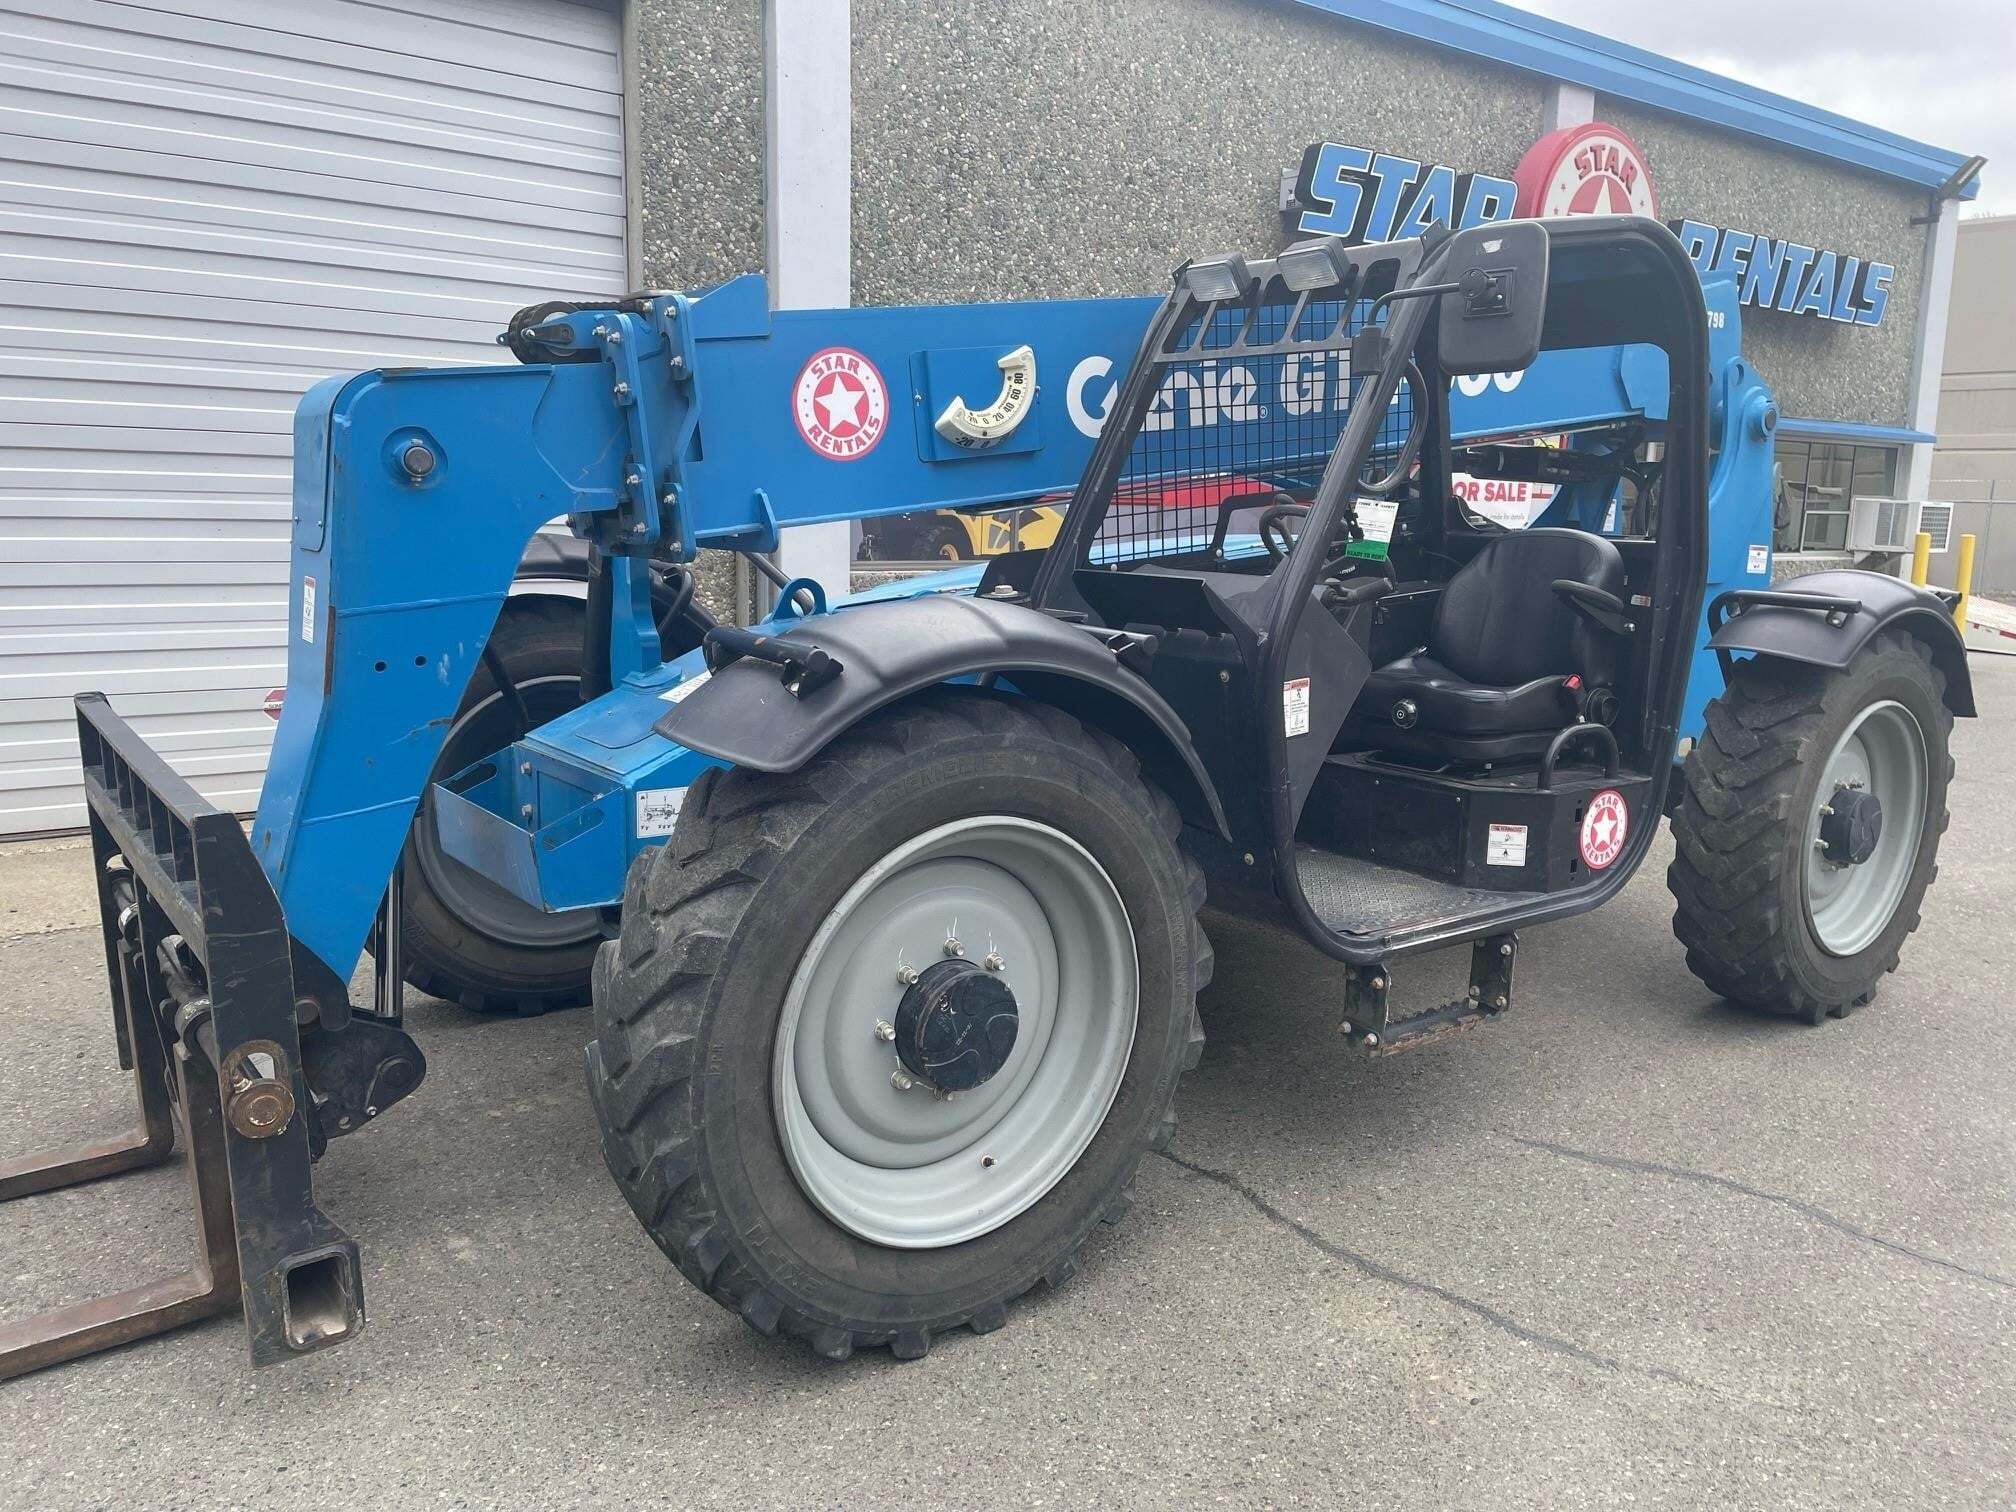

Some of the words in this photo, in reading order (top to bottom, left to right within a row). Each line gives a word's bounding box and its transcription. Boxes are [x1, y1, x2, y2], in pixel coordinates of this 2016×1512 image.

[1574, 144, 1638, 196] STAR
[1298, 141, 1518, 244] STAR
[1679, 219, 1895, 327] RENTALS
[1707, 310, 1725, 328] 798
[811, 355, 860, 380] STAR
[1013, 372, 1024, 385] 80
[1010, 388, 1022, 401] 60
[993, 412, 1004, 422] 20
[1003, 402, 1015, 413] 40
[808, 416, 881, 454] RENTALS
[1453, 481, 1480, 501] OR
[1484, 481, 1528, 502] SALE
[1595, 795, 1619, 810] STAR
[1585, 840, 1620, 863] RENTALS
